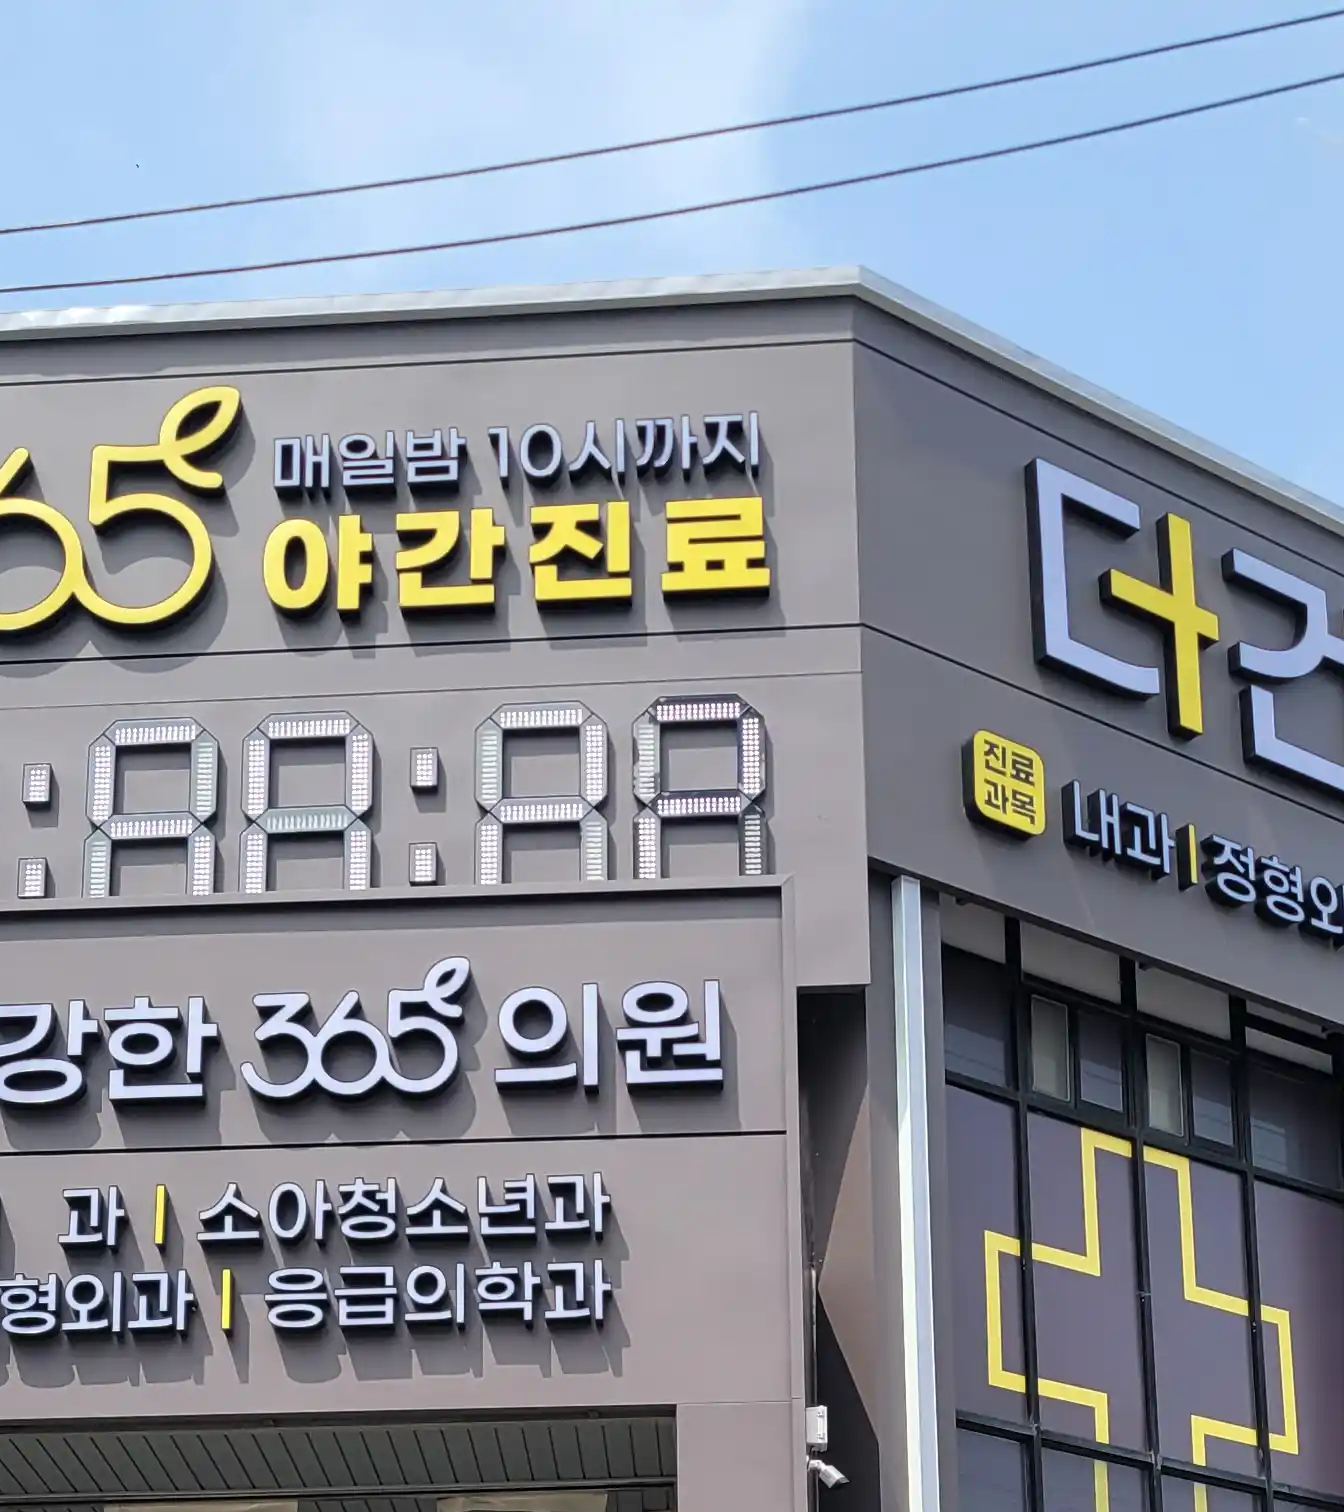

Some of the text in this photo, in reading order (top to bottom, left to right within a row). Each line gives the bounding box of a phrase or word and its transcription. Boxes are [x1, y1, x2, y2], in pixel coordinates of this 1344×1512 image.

[272, 412, 766, 494] 매일밤 10시까지
[263, 497, 771, 616] 야간진료
[1070, 780, 1175, 875] 내과
[241, 956, 470, 1100] 365
[494, 980, 723, 1094] 의원
[197, 1172, 611, 1245] 소아청소년과
[264, 1258, 612, 1332] 응급의학과
